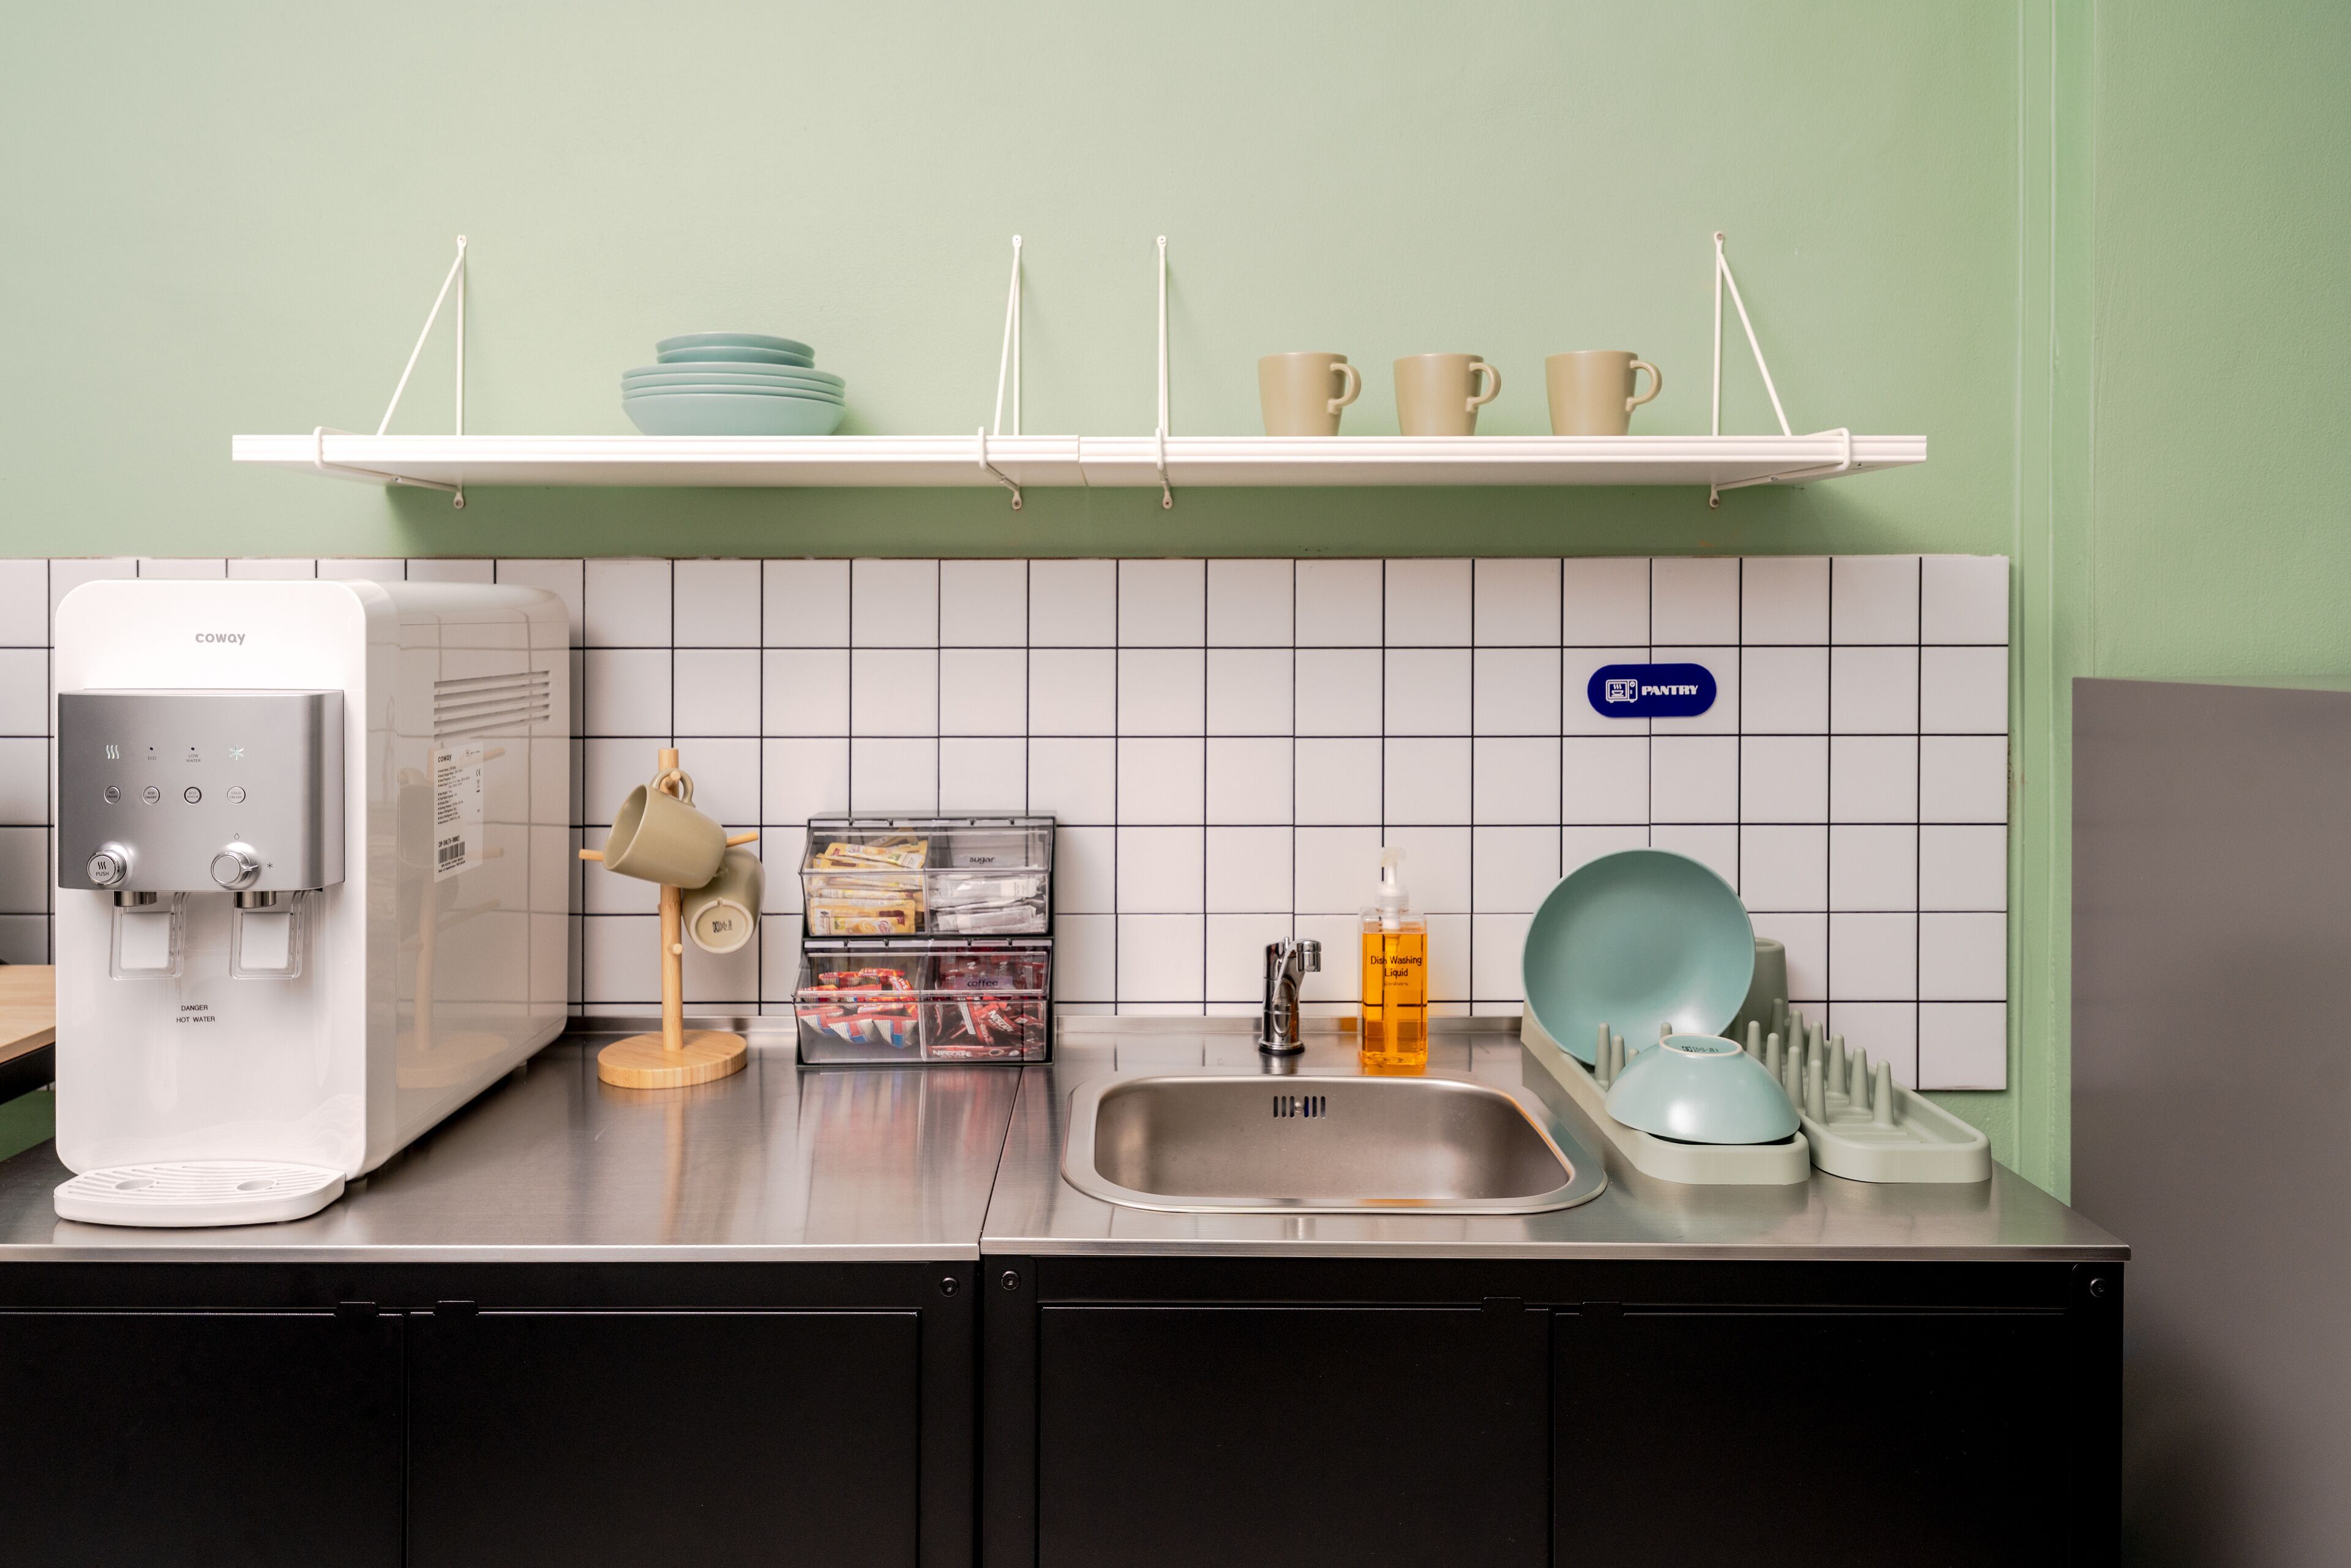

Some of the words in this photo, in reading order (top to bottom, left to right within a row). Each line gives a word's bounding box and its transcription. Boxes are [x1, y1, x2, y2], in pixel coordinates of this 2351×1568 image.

[195, 633, 246, 646] coway
[1641, 685, 1698, 696] PANTRY
[969, 856, 996, 865] sugar
[1371, 955, 1387, 965] Dish
[1390, 955, 1422, 967] Washing
[1384, 968, 1408, 980] Liquid
[967, 979, 999, 988] coffee
